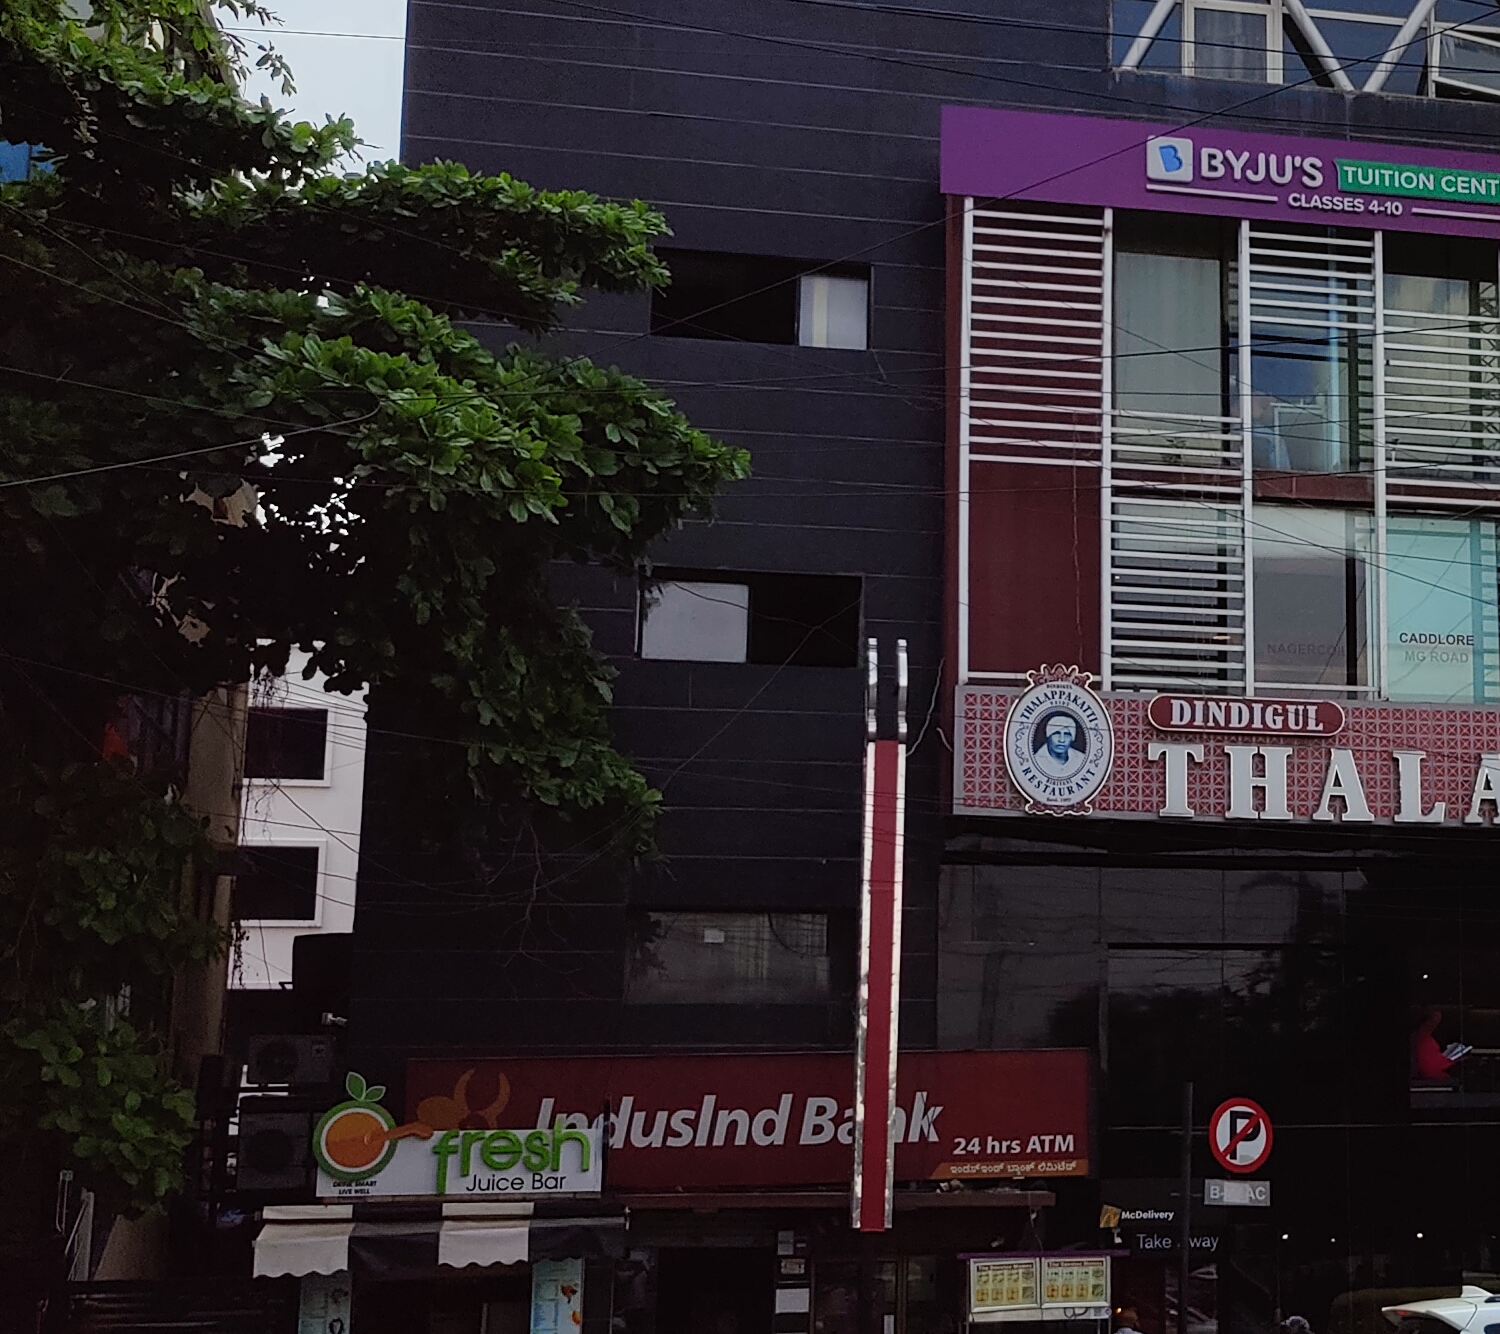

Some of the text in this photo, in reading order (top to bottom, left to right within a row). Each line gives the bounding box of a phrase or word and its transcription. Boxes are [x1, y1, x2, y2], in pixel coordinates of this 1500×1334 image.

[1201, 147, 1324, 188] BYJU'S
[1344, 166, 1436, 191] TUITION
[1287, 192, 1403, 216] CLASSES 4-10
[1399, 632, 1475, 646] CADDLORE
[1404, 650, 1469, 663] MG ROAD
[1020, 690, 1099, 723] THALAPPAKATTI
[1170, 699, 1324, 732] DINDIGUL
[1022, 767, 1095, 797] RESTAURANT
[798, 1090, 944, 1146] Bk
[432, 1117, 591, 1195] fresh
[953, 1134, 1075, 1155] 24 hrs ATM
[466, 1173, 566, 1192] Juice Bar
[1209, 1185, 1267, 1201] B-AC
[1121, 1210, 1174, 1220] McDelivery
[1136, 1233, 1219, 1251] Take way
